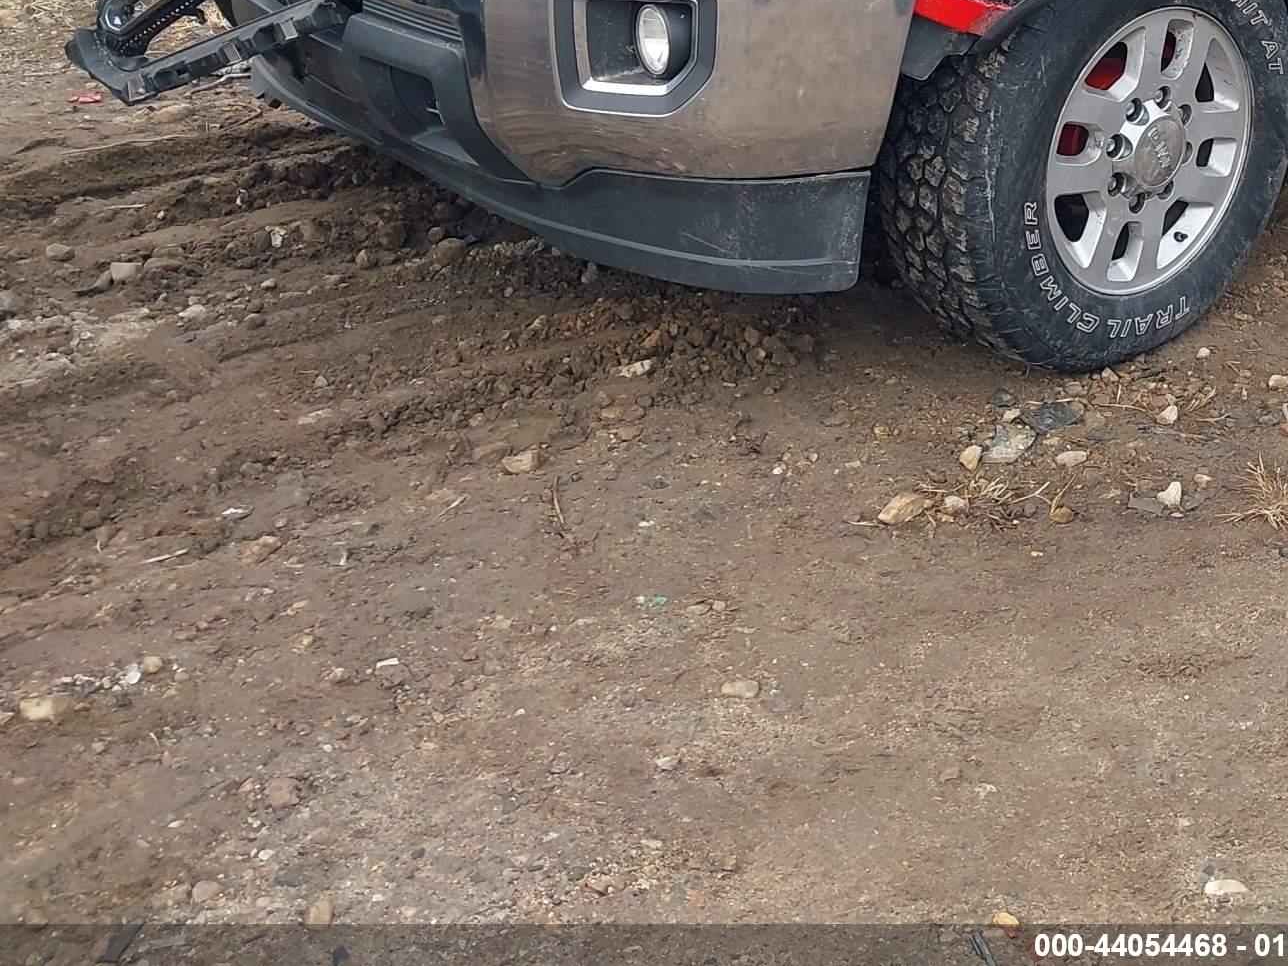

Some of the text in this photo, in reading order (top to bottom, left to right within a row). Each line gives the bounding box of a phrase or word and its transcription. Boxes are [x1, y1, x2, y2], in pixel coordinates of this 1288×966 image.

[1261, 40, 1284, 75] AT
[1024, 202, 1190, 338] TRAIL CLIMBER
